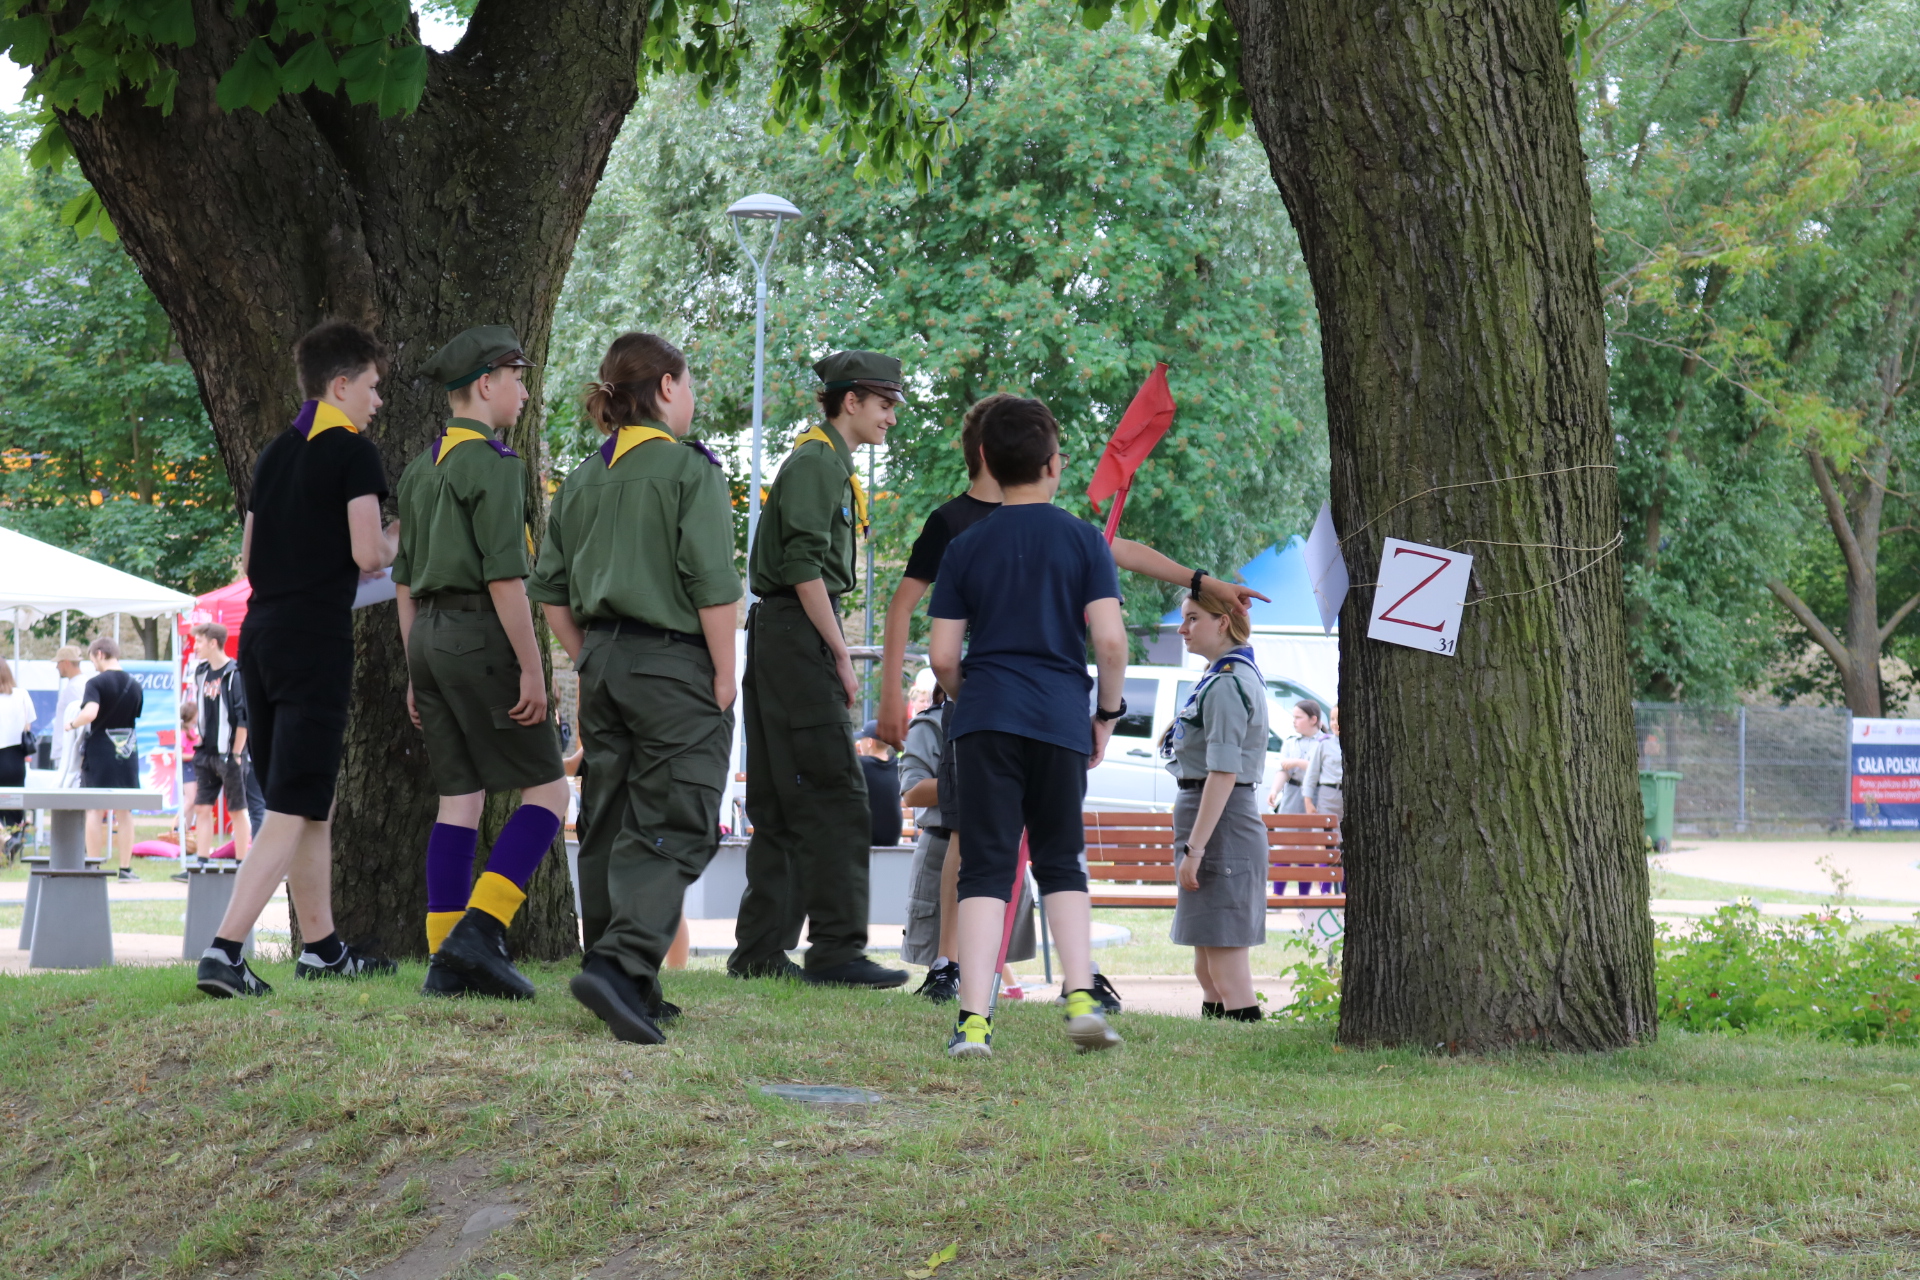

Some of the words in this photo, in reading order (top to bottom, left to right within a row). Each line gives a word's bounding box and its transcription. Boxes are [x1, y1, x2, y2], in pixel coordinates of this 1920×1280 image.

[1378, 547, 1452, 633] Z
[1434, 638, 1455, 653] 31
[1858, 757, 1885, 774] CAŁA
[1886, 756, 1920, 774] POLSK
